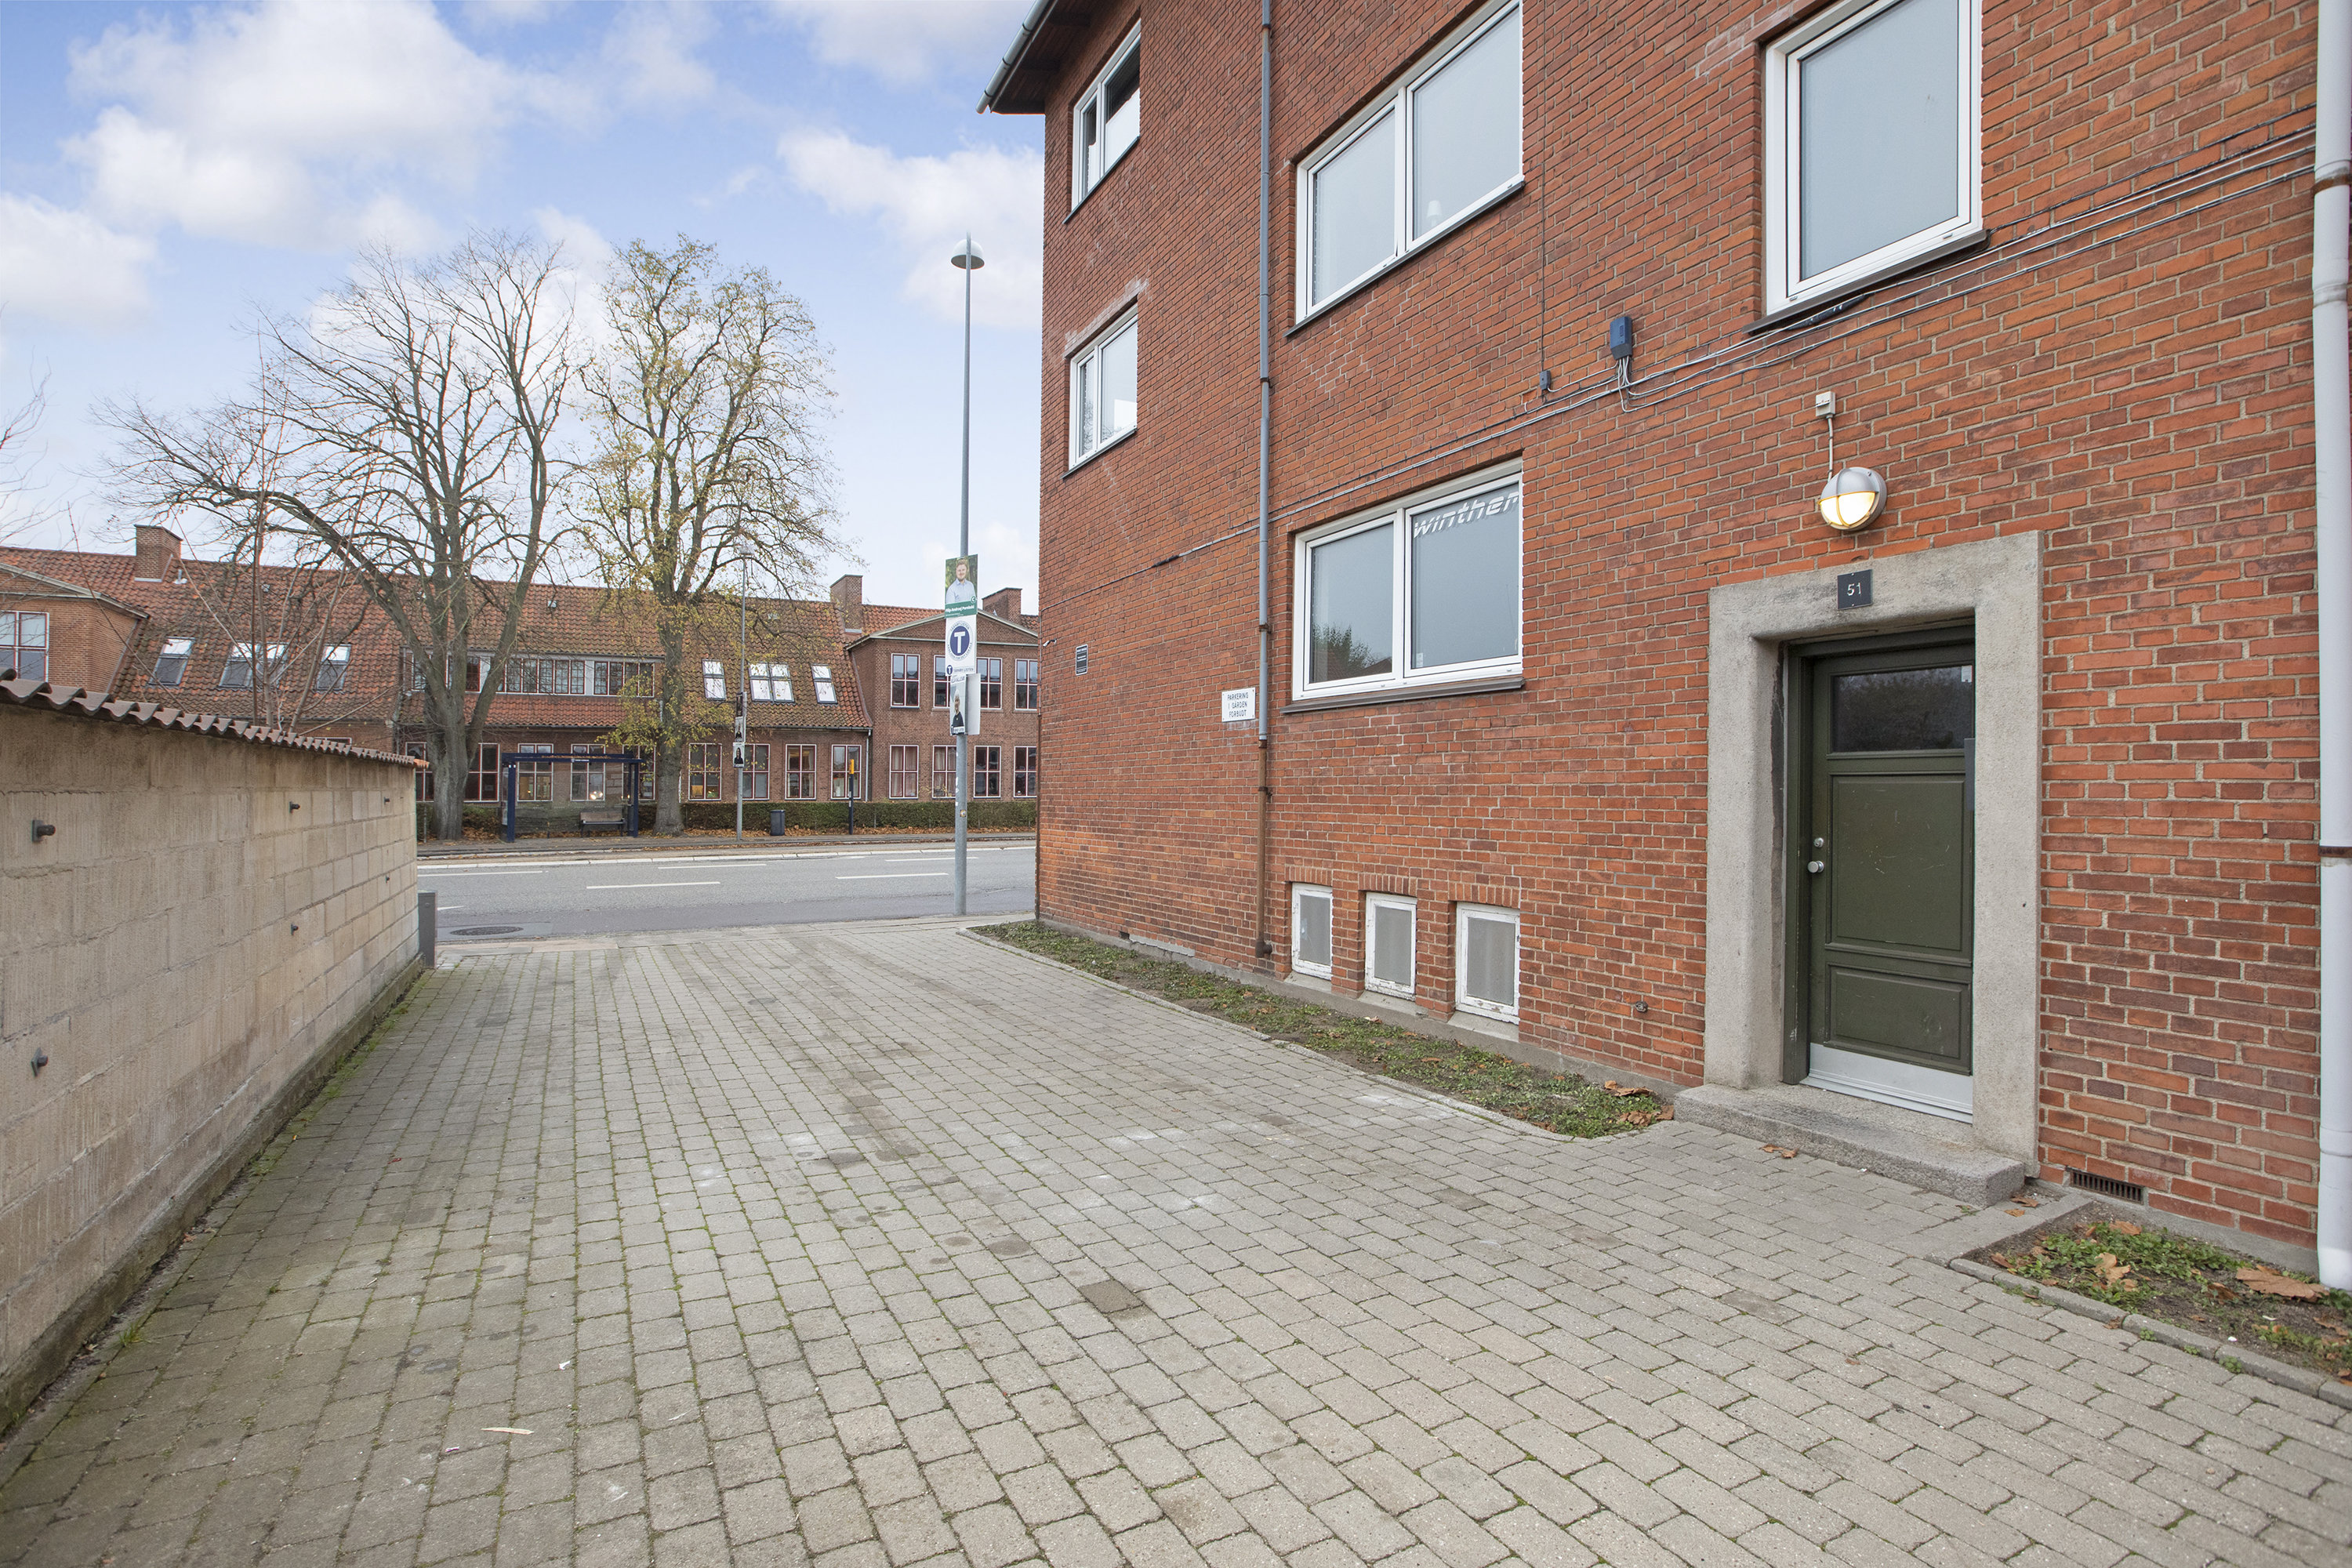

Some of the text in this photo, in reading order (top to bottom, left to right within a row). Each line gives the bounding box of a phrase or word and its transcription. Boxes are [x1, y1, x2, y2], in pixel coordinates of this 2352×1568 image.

[1414, 491, 1519, 538] winther
[1847, 583, 1862, 596] 51
[954, 631, 965, 654] T
[1227, 692, 1249, 701] PARKERING
[1229, 710, 1247, 718] FORBUDT
